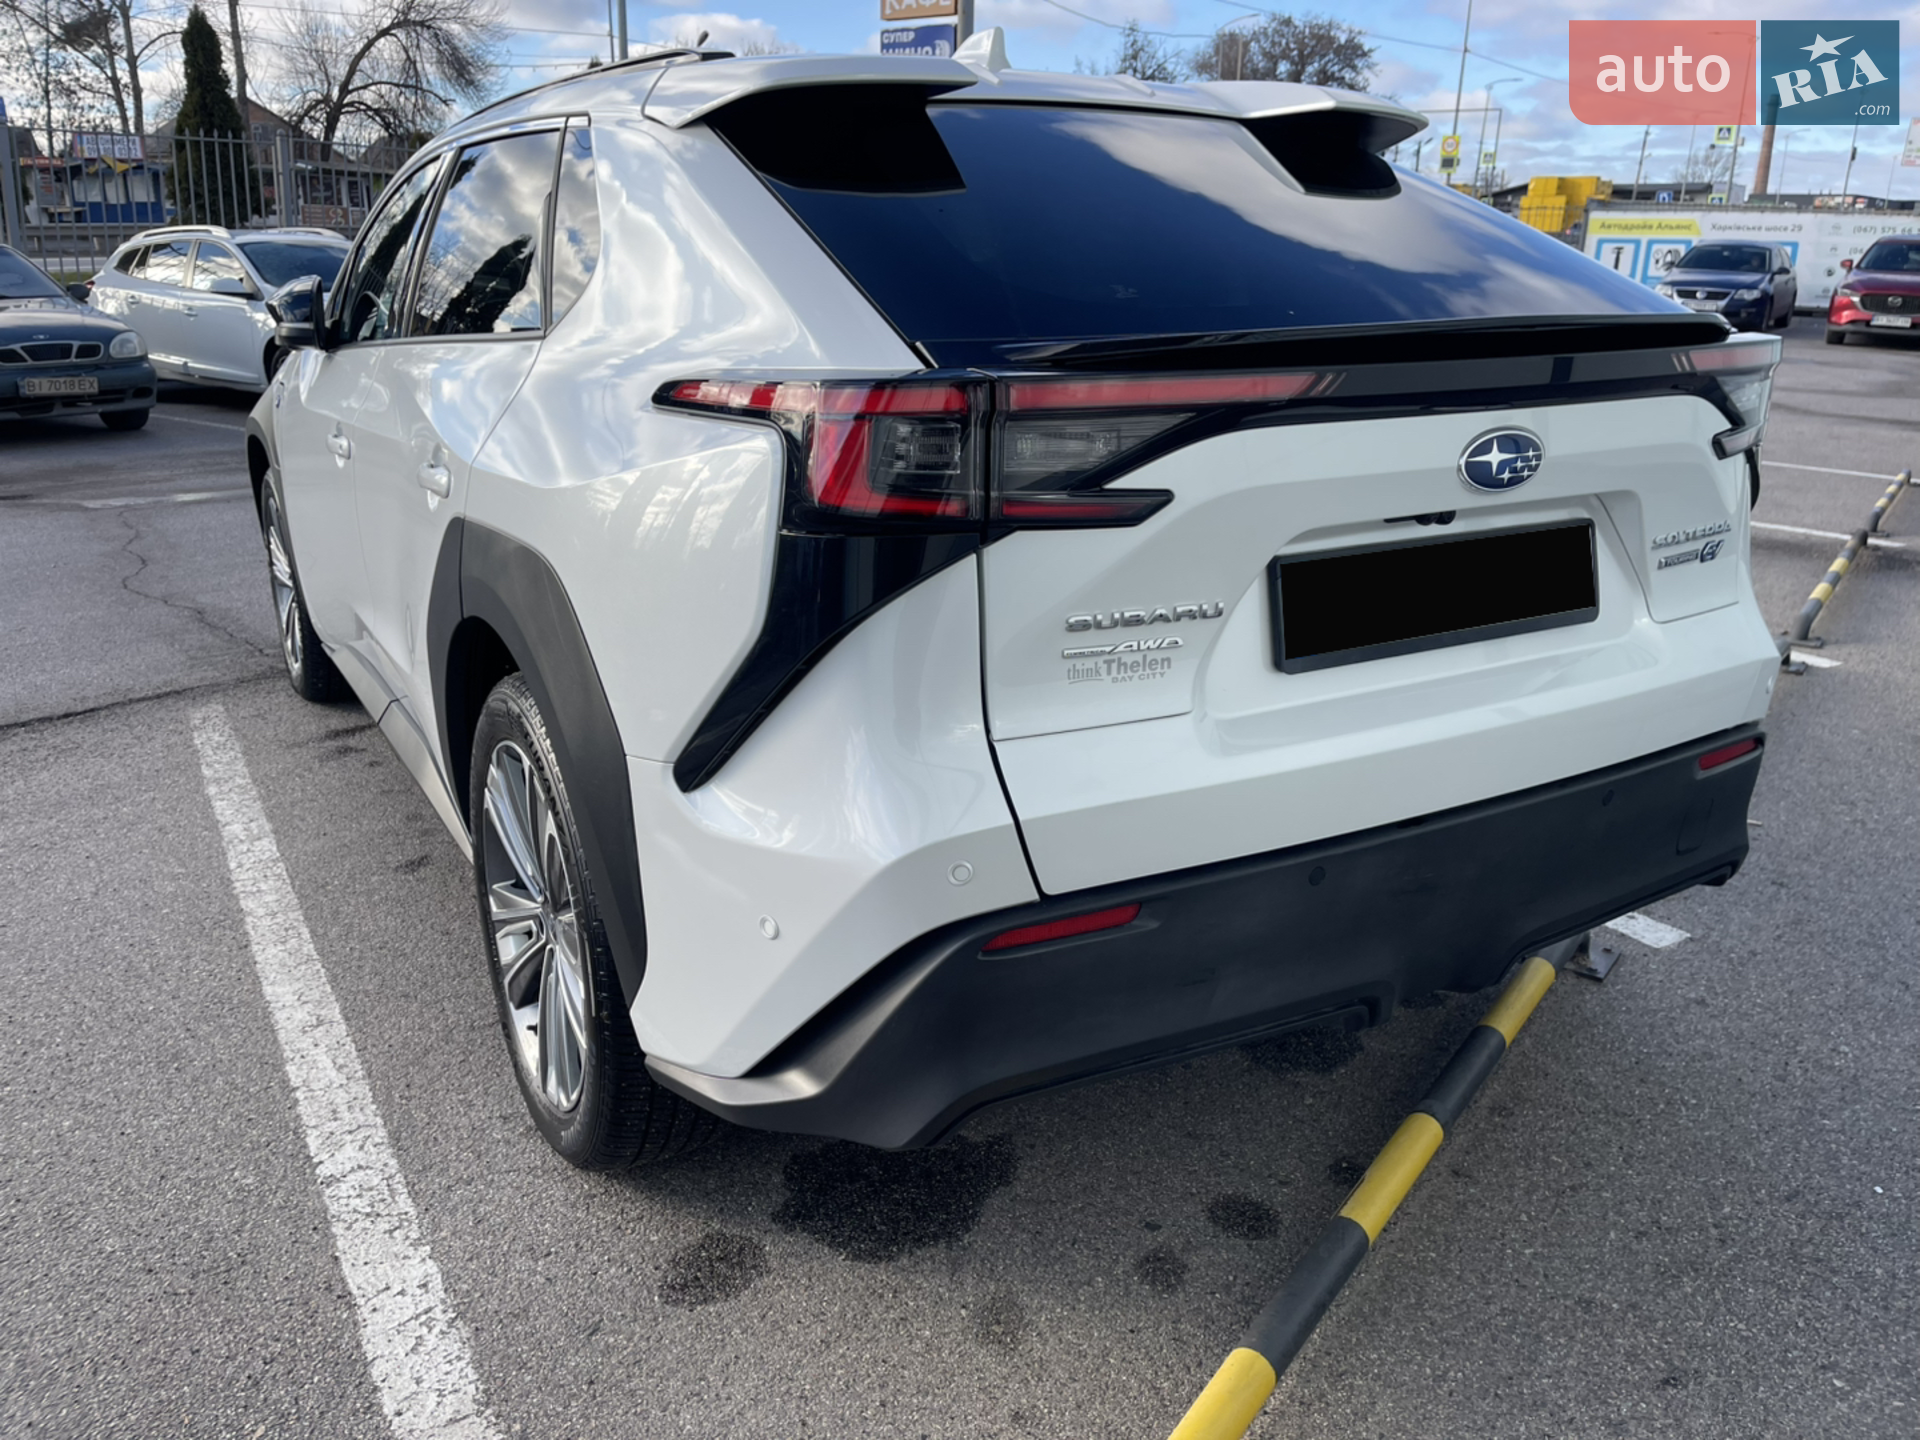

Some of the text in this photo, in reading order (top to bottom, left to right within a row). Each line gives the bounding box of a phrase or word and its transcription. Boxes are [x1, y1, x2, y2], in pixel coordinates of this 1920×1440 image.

[882, 31, 916, 44] СУПЕР
[1790, 224, 1803, 232] 29
[47, 379, 76, 392] 7018
[78, 379, 96, 391] EX
[1065, 602, 1225, 632] SUBARU
[1108, 636, 1184, 655] AWD
[1067, 653, 1172, 681] think Thelen
[1138, 671, 1166, 681] CITY
